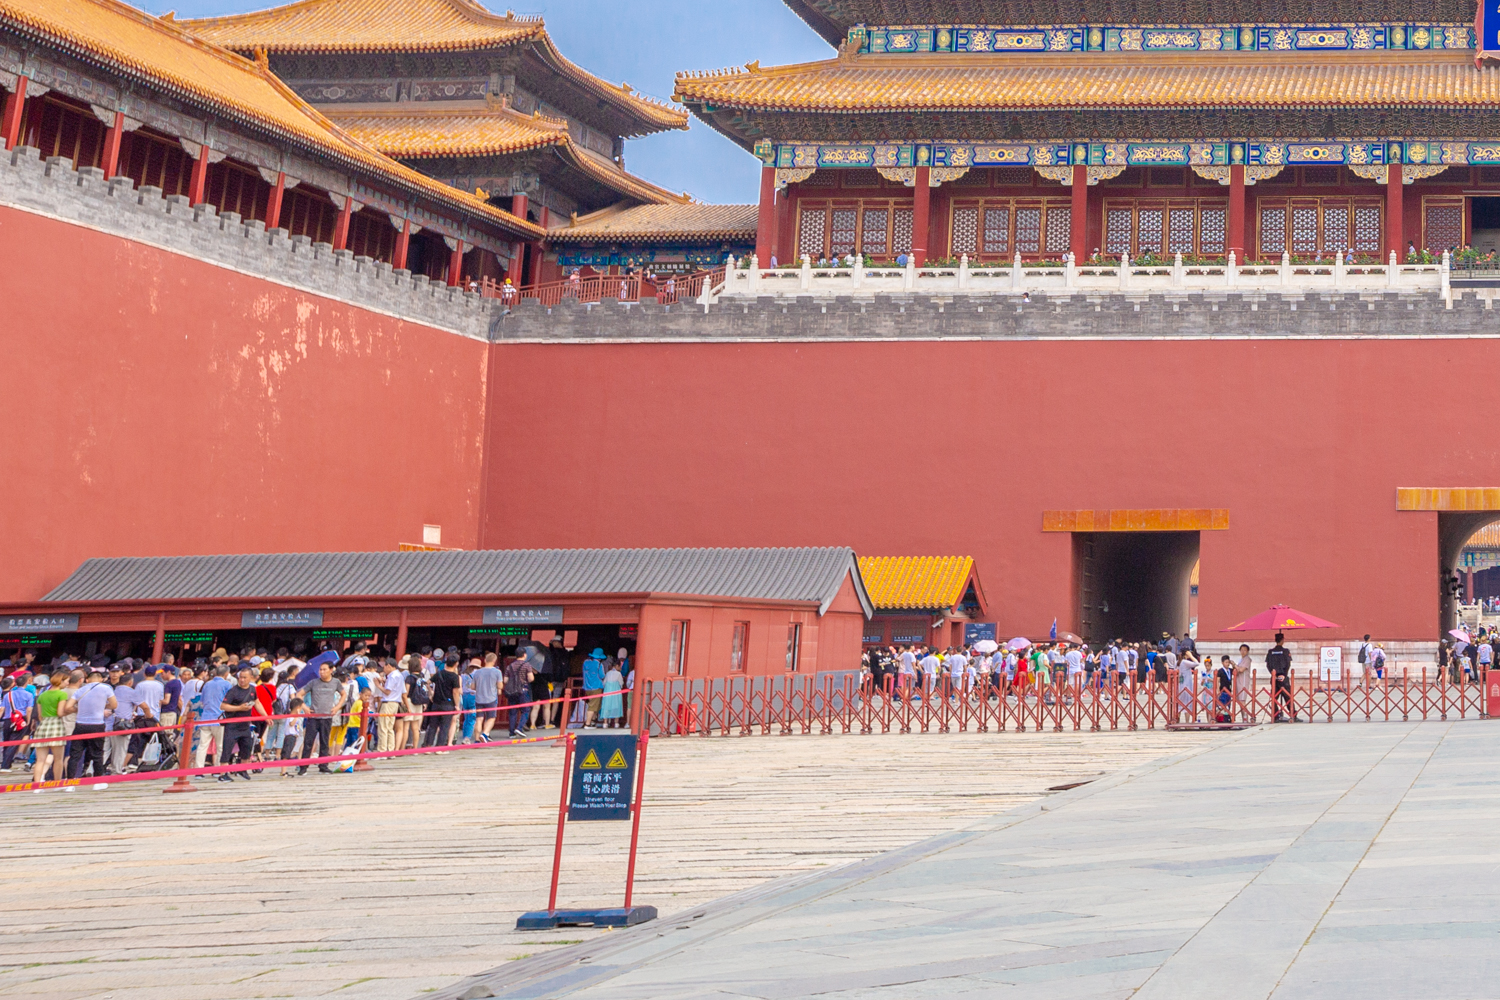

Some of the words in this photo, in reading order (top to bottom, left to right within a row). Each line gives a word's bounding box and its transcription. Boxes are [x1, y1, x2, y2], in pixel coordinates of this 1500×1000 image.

[582, 772, 622, 783] 路面不平
[39, 780, 61, 788] LIMIT
[63, 778, 82, 786] LINE
[582, 784, 620, 794] 当心跌滑
